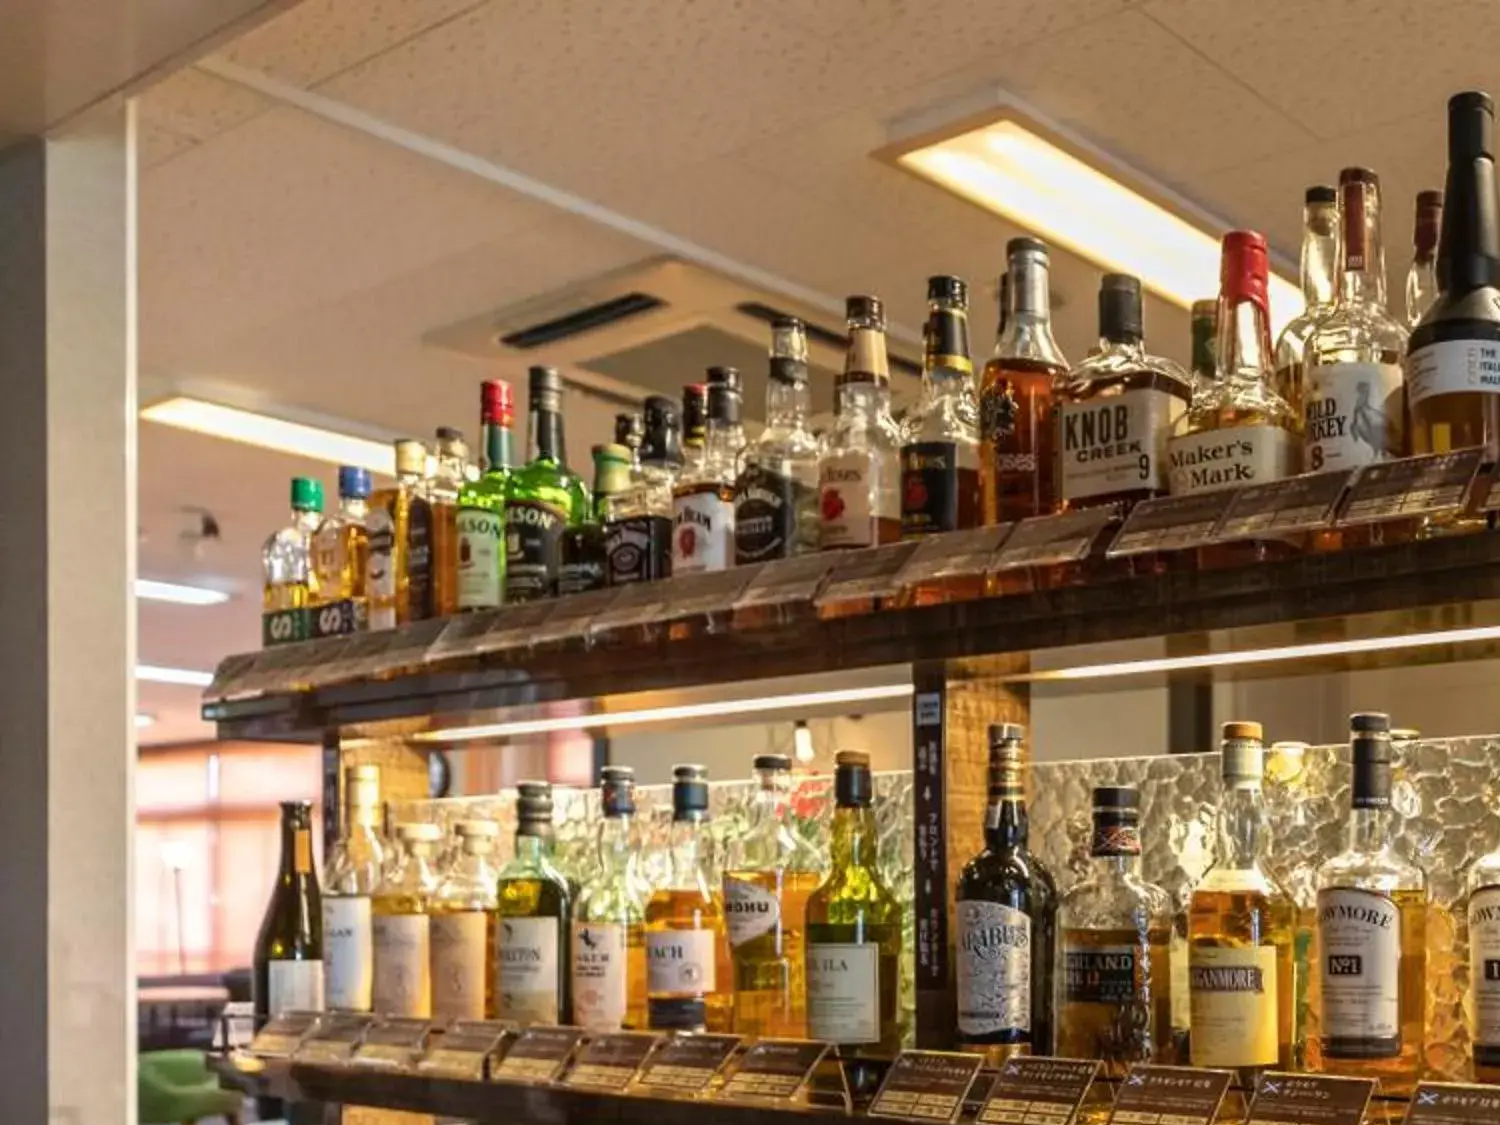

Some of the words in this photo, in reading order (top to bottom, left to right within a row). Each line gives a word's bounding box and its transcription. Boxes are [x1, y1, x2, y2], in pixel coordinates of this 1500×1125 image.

[1065, 404, 1128, 451] KNOB
[1077, 440, 1142, 463] CREEK
[1169, 438, 1253, 469] Maker's
[1311, 445, 1324, 471] 8
[1138, 453, 1150, 480] 9
[1190, 462, 1255, 489] Mark
[1320, 904, 1393, 930] OWMORE
